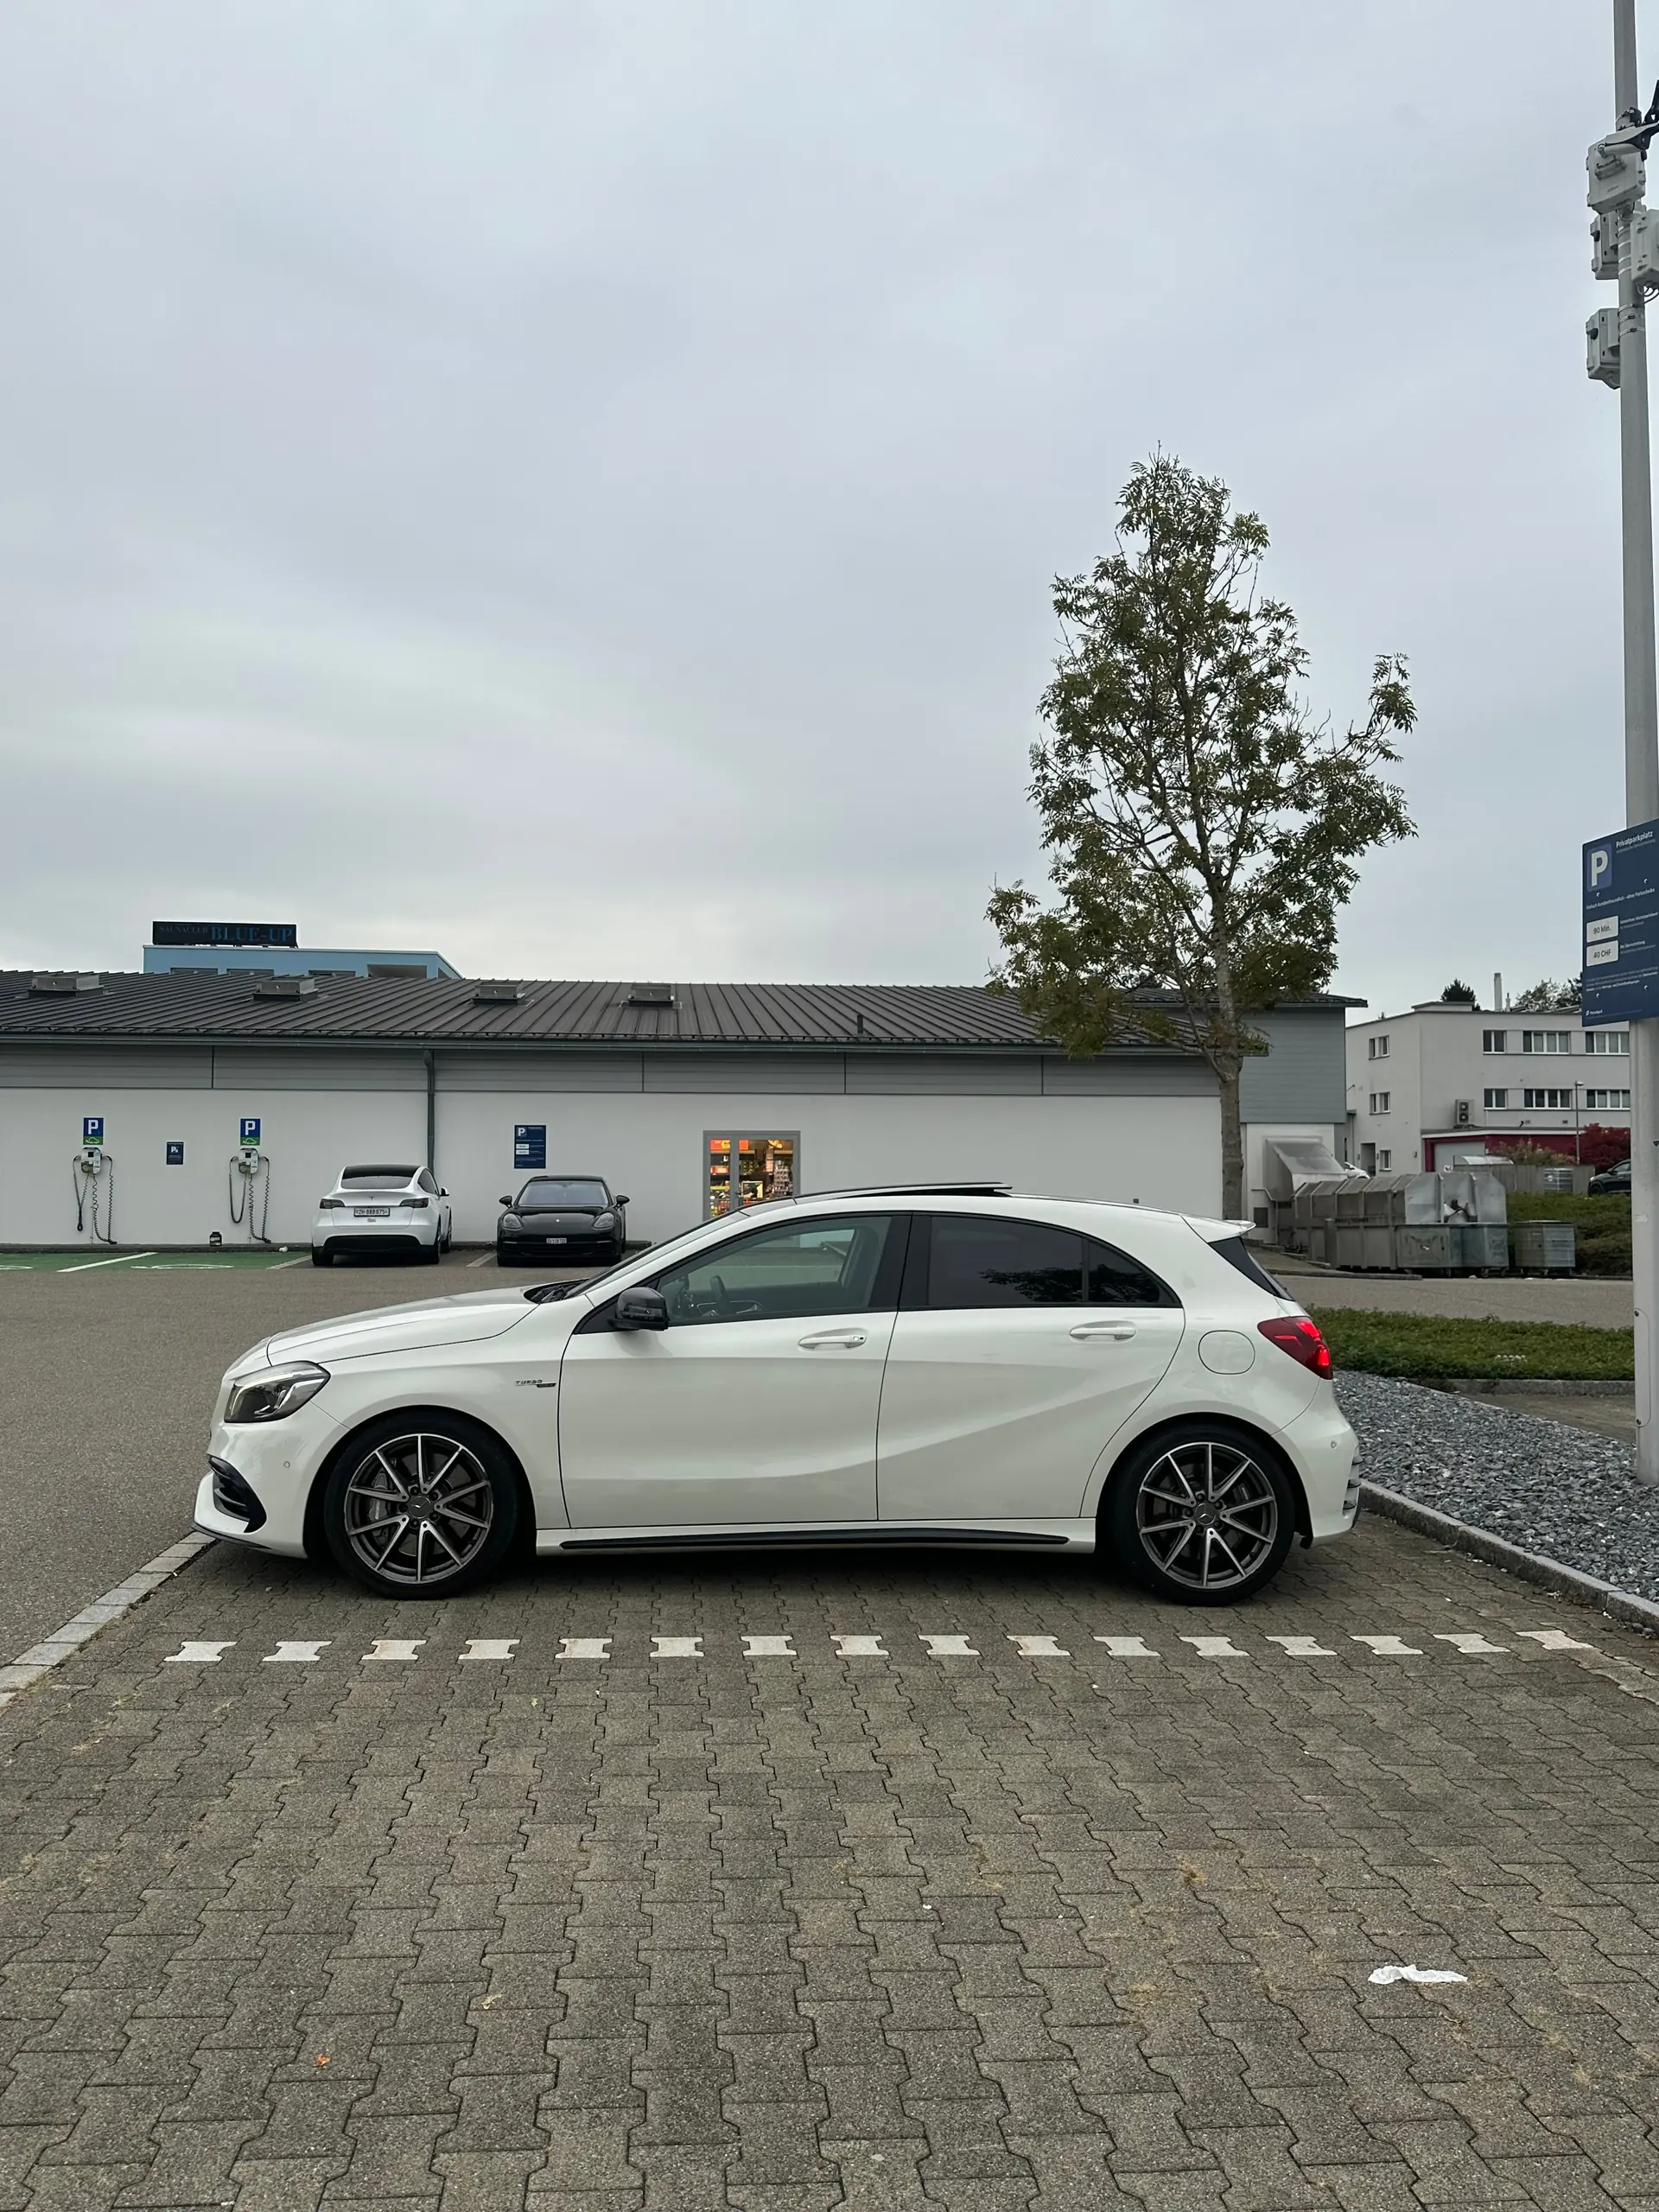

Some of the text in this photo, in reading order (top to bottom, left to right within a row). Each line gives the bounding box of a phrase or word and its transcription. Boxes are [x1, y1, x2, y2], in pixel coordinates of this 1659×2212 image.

[1616, 830, 1653, 849] Privatparkplatz
[1591, 850, 1608, 887] P
[211, 926, 293, 942] BLUE-UP
[1592, 926, 1600, 935] 90
[1601, 925, 1611, 933] Min.
[1601, 949, 1611, 957] CHF
[87, 1119, 99, 1135] P
[245, 1120, 256, 1135] P
[518, 1127, 525, 1137] P
